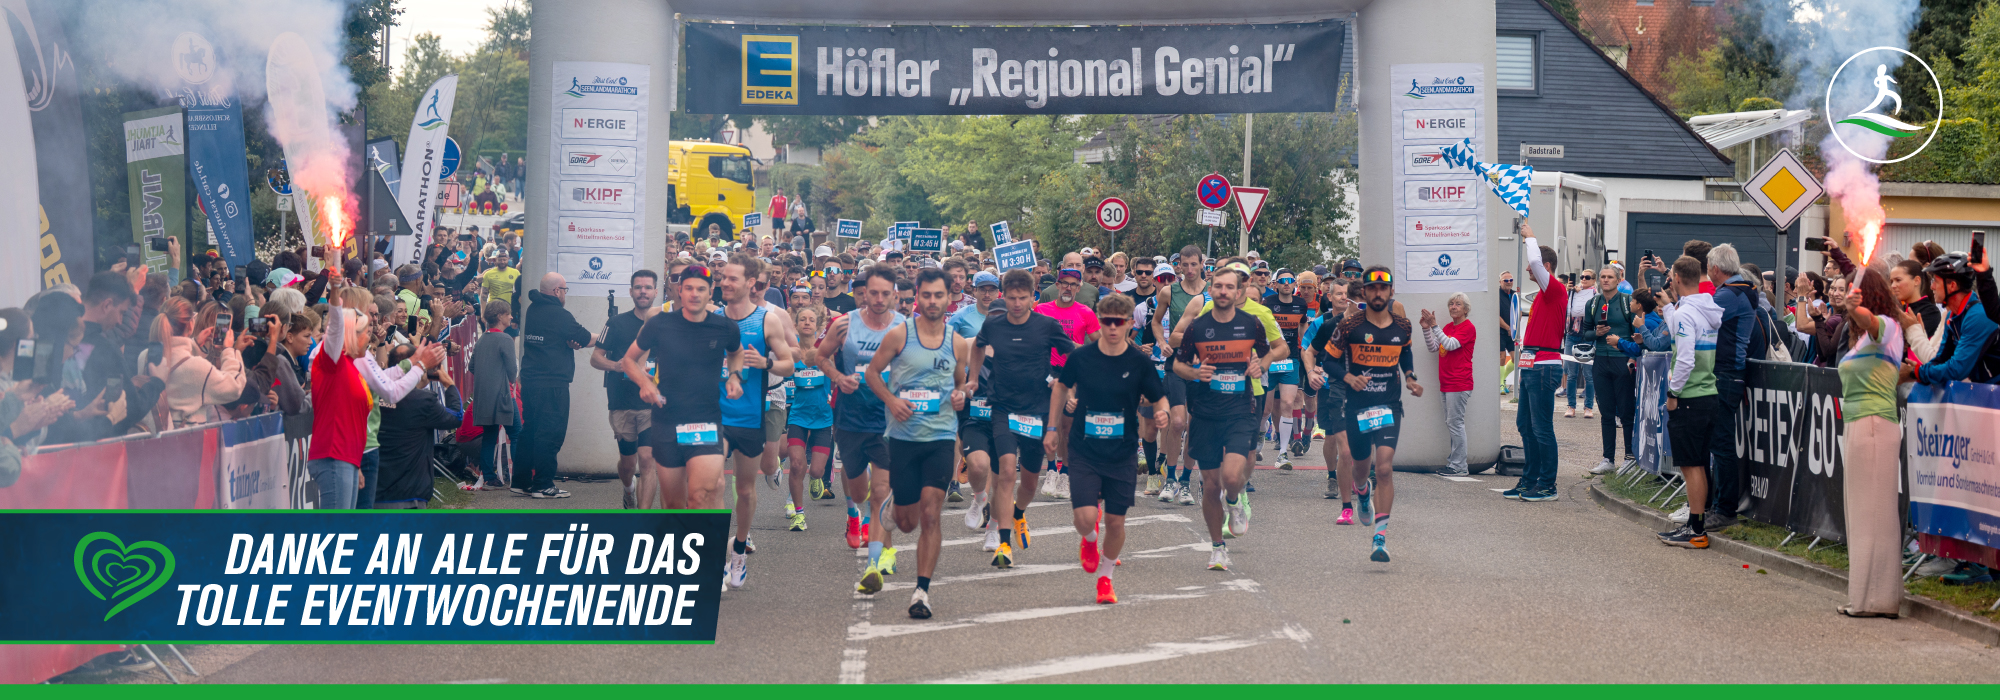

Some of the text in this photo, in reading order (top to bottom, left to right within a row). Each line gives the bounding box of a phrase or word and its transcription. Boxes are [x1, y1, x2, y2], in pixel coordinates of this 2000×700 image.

[816, 43, 1296, 109] Höfler „Regional Genial“
[746, 89, 794, 100] EDEKA
[1528, 146, 1561, 155] Badstraße
[570, 156, 588, 164] GORE
[585, 187, 623, 202] KIPF
[1431, 186, 1466, 199] KIPF
[1103, 208, 1123, 223] 30
[577, 226, 605, 234] Sparkasse
[576, 233, 625, 241] Mittelfranken-Süd
[914, 239, 939, 248] M 3:45 H
[1001, 258, 1009, 269] M
[1009, 256, 1025, 268] 3:30
[1025, 253, 1031, 264] H
[1205, 344, 1226, 352] TEAM
[1359, 345, 1382, 353] TEAM
[933, 357, 950, 372] LAC
[806, 378, 811, 386] 2
[1220, 382, 1236, 391] 308
[1368, 417, 1383, 428] 307
[1734, 386, 1803, 468] ORE-TEX
[1018, 423, 1033, 435] 337
[1095, 426, 1113, 435] 329
[694, 433, 701, 442] 3
[1936, 474, 1955, 488] und
